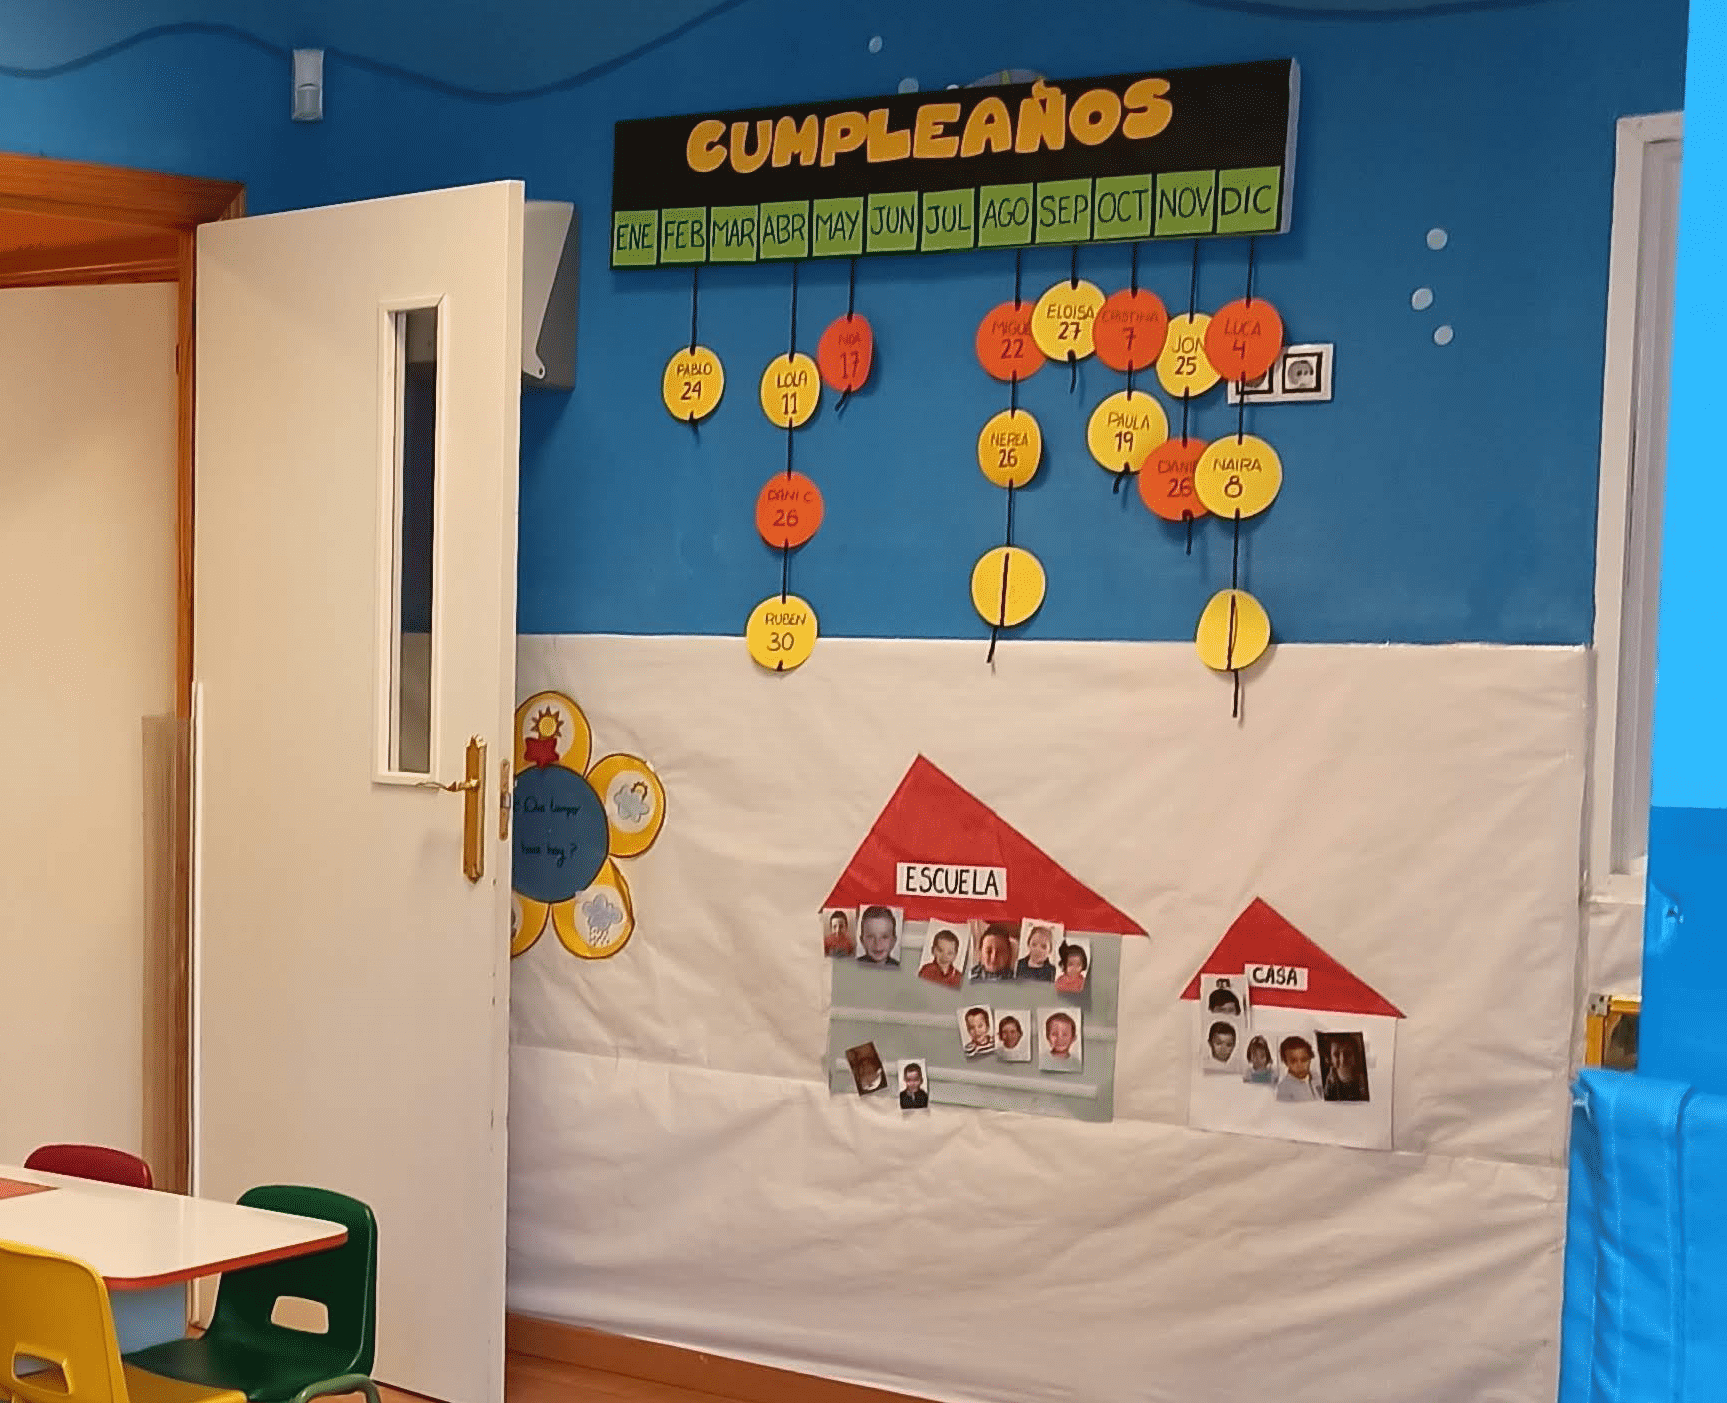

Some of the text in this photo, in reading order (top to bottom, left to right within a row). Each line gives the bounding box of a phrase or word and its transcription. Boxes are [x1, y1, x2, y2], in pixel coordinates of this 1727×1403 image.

[686, 78, 1173, 174] CUMPLEAÑOS
[615, 184, 1272, 251] ENE FEB MAR ABR MAY JUN JUL AGO SEP OCT NOV DIC
[1046, 303, 1095, 320] ELOISA
[1057, 321, 1082, 340] 27
[1224, 317, 1262, 336] LUCA
[1000, 338, 1024, 360] 22
[1122, 326, 1136, 351] 7
[1232, 339, 1246, 360] 4
[676, 362, 713, 376] PABLO
[839, 350, 860, 380] 17
[1174, 356, 1197, 376] 25
[776, 370, 808, 389] LOLA
[680, 380, 702, 401] 24
[781, 392, 798, 415] 11
[1107, 411, 1150, 431] PAULA
[990, 432, 1029, 447] NEREA
[1114, 430, 1134, 452] 19
[998, 448, 1018, 469] 26
[1212, 457, 1263, 474] NAIRA
[1167, 477, 1193, 498] 26
[1224, 474, 1244, 499] 8
[773, 509, 799, 528] 26
[764, 612, 807, 626] RUBEN
[766, 631, 795, 652] 30
[905, 866, 1000, 896] ESCUELA
[1251, 965, 1299, 988] CASA
